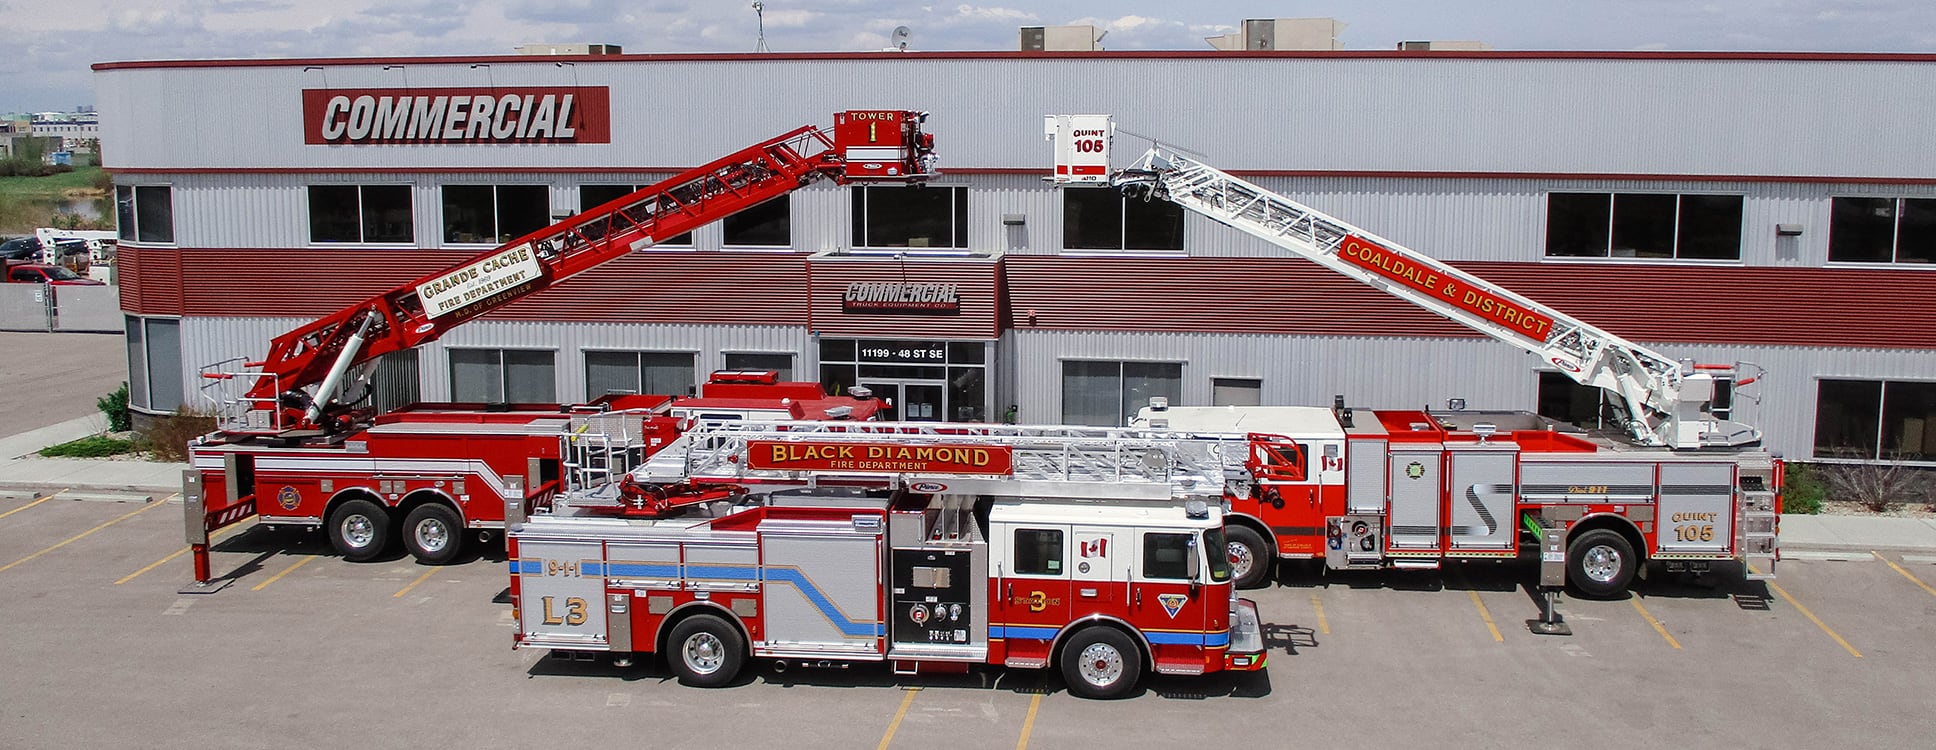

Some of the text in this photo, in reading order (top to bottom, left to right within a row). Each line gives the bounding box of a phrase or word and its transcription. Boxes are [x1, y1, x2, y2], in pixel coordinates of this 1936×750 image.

[321, 94, 576, 141] COMMERCIAL
[850, 112, 894, 121] TOWER
[869, 121, 877, 142] 1
[1073, 129, 1105, 137] QUINT
[1074, 139, 1104, 153] 105
[423, 247, 530, 299] GRANDE CACHE
[438, 270, 526, 311] FIRE DEPARTMENT
[473, 303, 484, 312] OF
[487, 283, 532, 306] GREENVIEW
[845, 282, 958, 303] COMMERCIAL
[1345, 241, 1548, 336] COALDALE & DISTRICT
[861, 348, 890, 358] 11199
[898, 349, 911, 358] 48
[913, 349, 927, 358] ST
[929, 349, 943, 359] SE
[771, 444, 990, 466] BLACK DIAMOND
[830, 460, 928, 470] FIRE DEPARTMENT
[1671, 511, 1717, 523] QUINT
[1674, 525, 1715, 542] 105
[548, 559, 580, 577] 9-1-1
[541, 595, 588, 626] L3
[1030, 590, 1047, 612] 3
